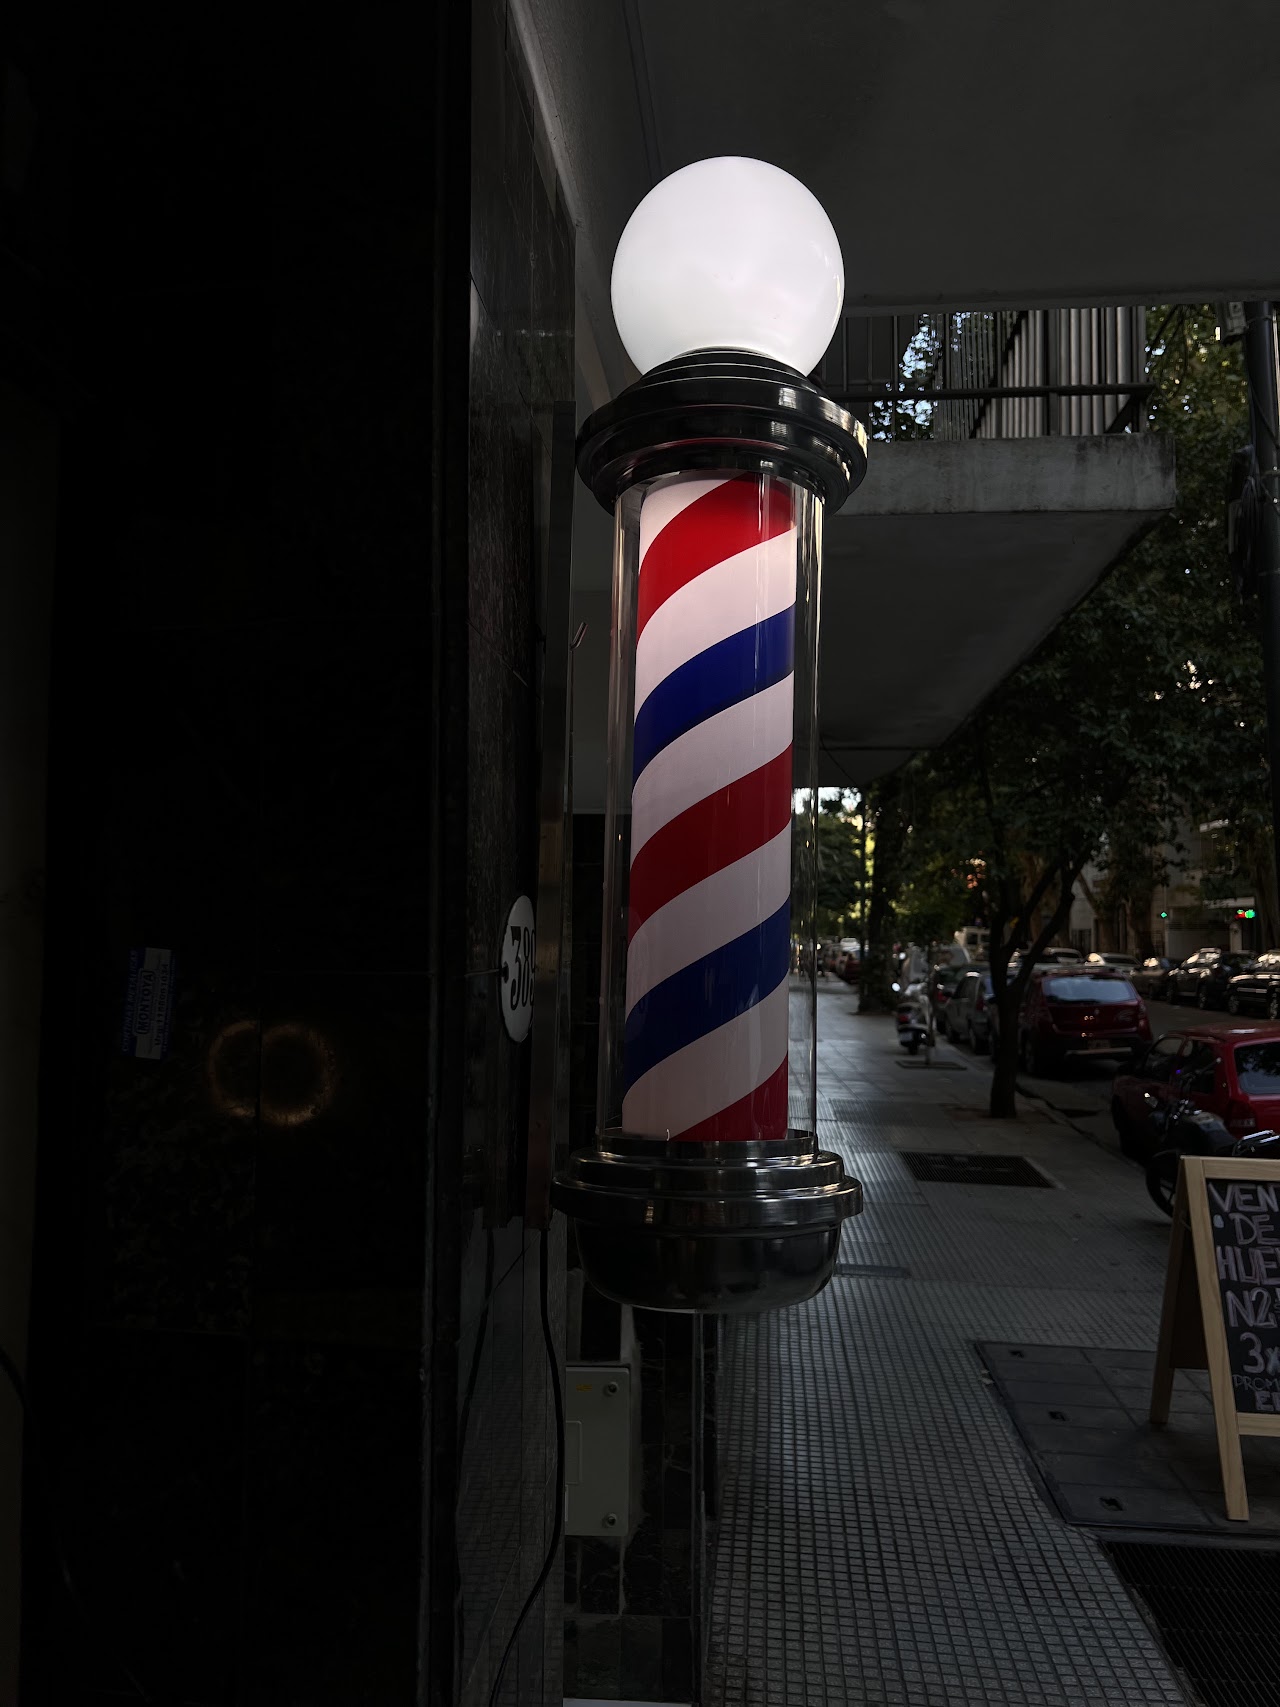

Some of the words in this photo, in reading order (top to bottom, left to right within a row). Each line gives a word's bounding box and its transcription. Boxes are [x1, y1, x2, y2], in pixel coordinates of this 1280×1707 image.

[137, 974, 154, 1031] MONTOYA
[1208, 1182, 1280, 1212] VEN
[1228, 1212, 1280, 1246] DE
